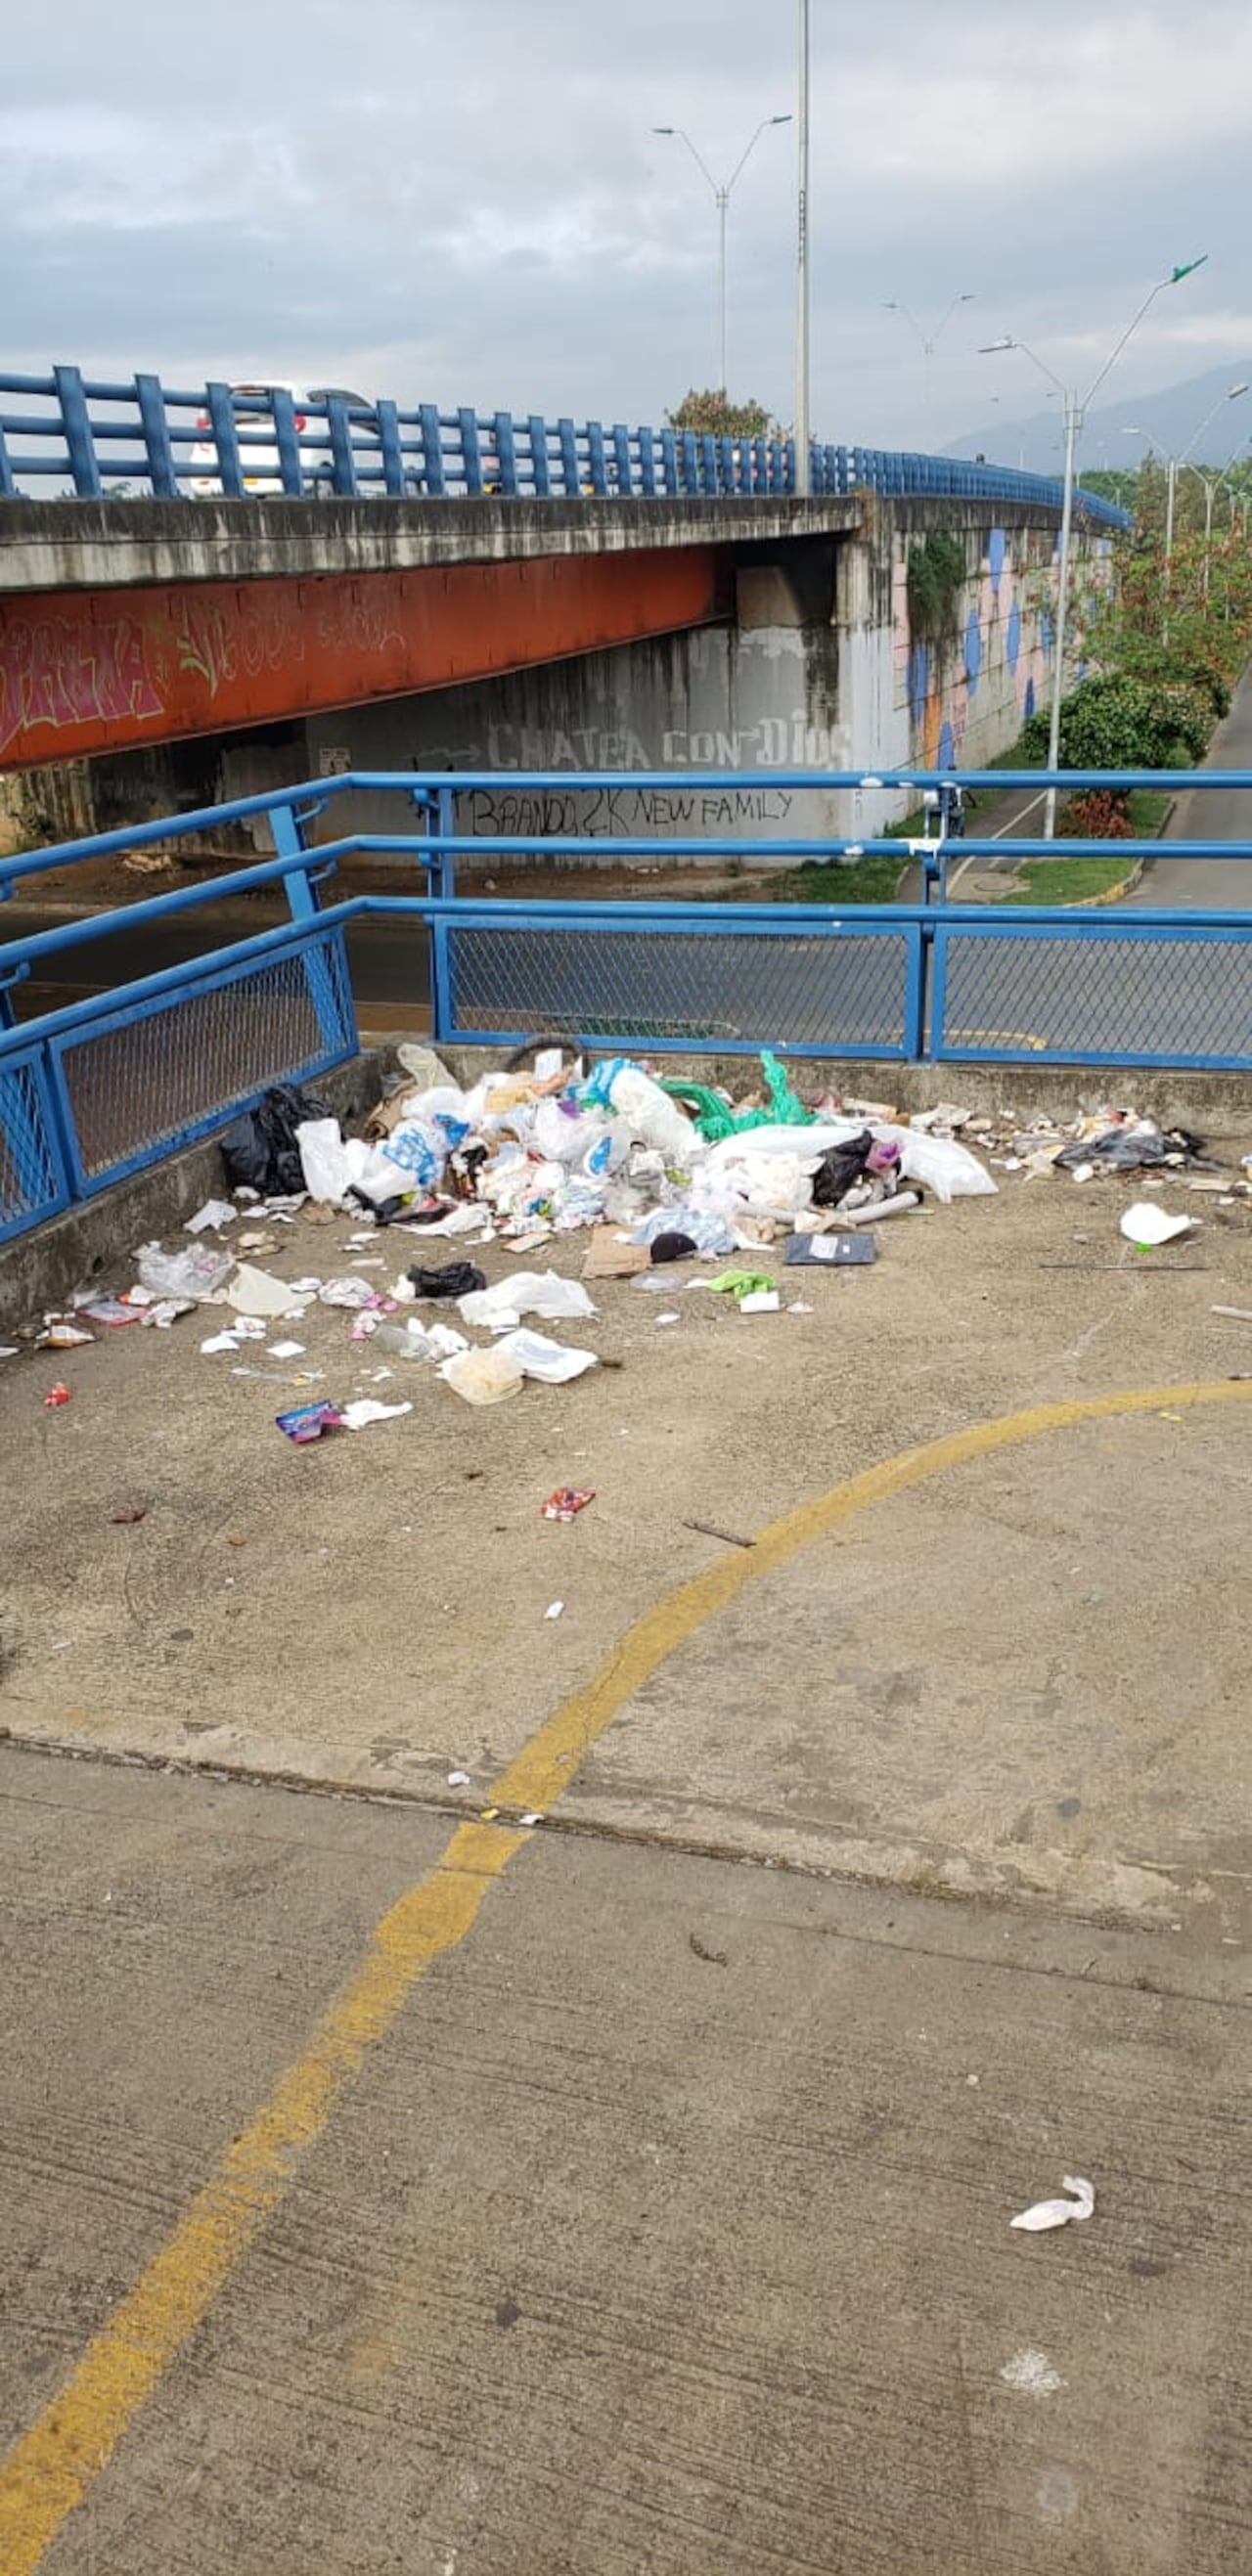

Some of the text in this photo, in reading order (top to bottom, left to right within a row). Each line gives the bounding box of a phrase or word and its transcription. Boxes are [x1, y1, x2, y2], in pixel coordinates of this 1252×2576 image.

[488, 723, 651, 771] CHATEA
[662, 730, 741, 768] CON
[632, 789, 694, 825] NEW
[701, 791, 793, 825] FAMILY
